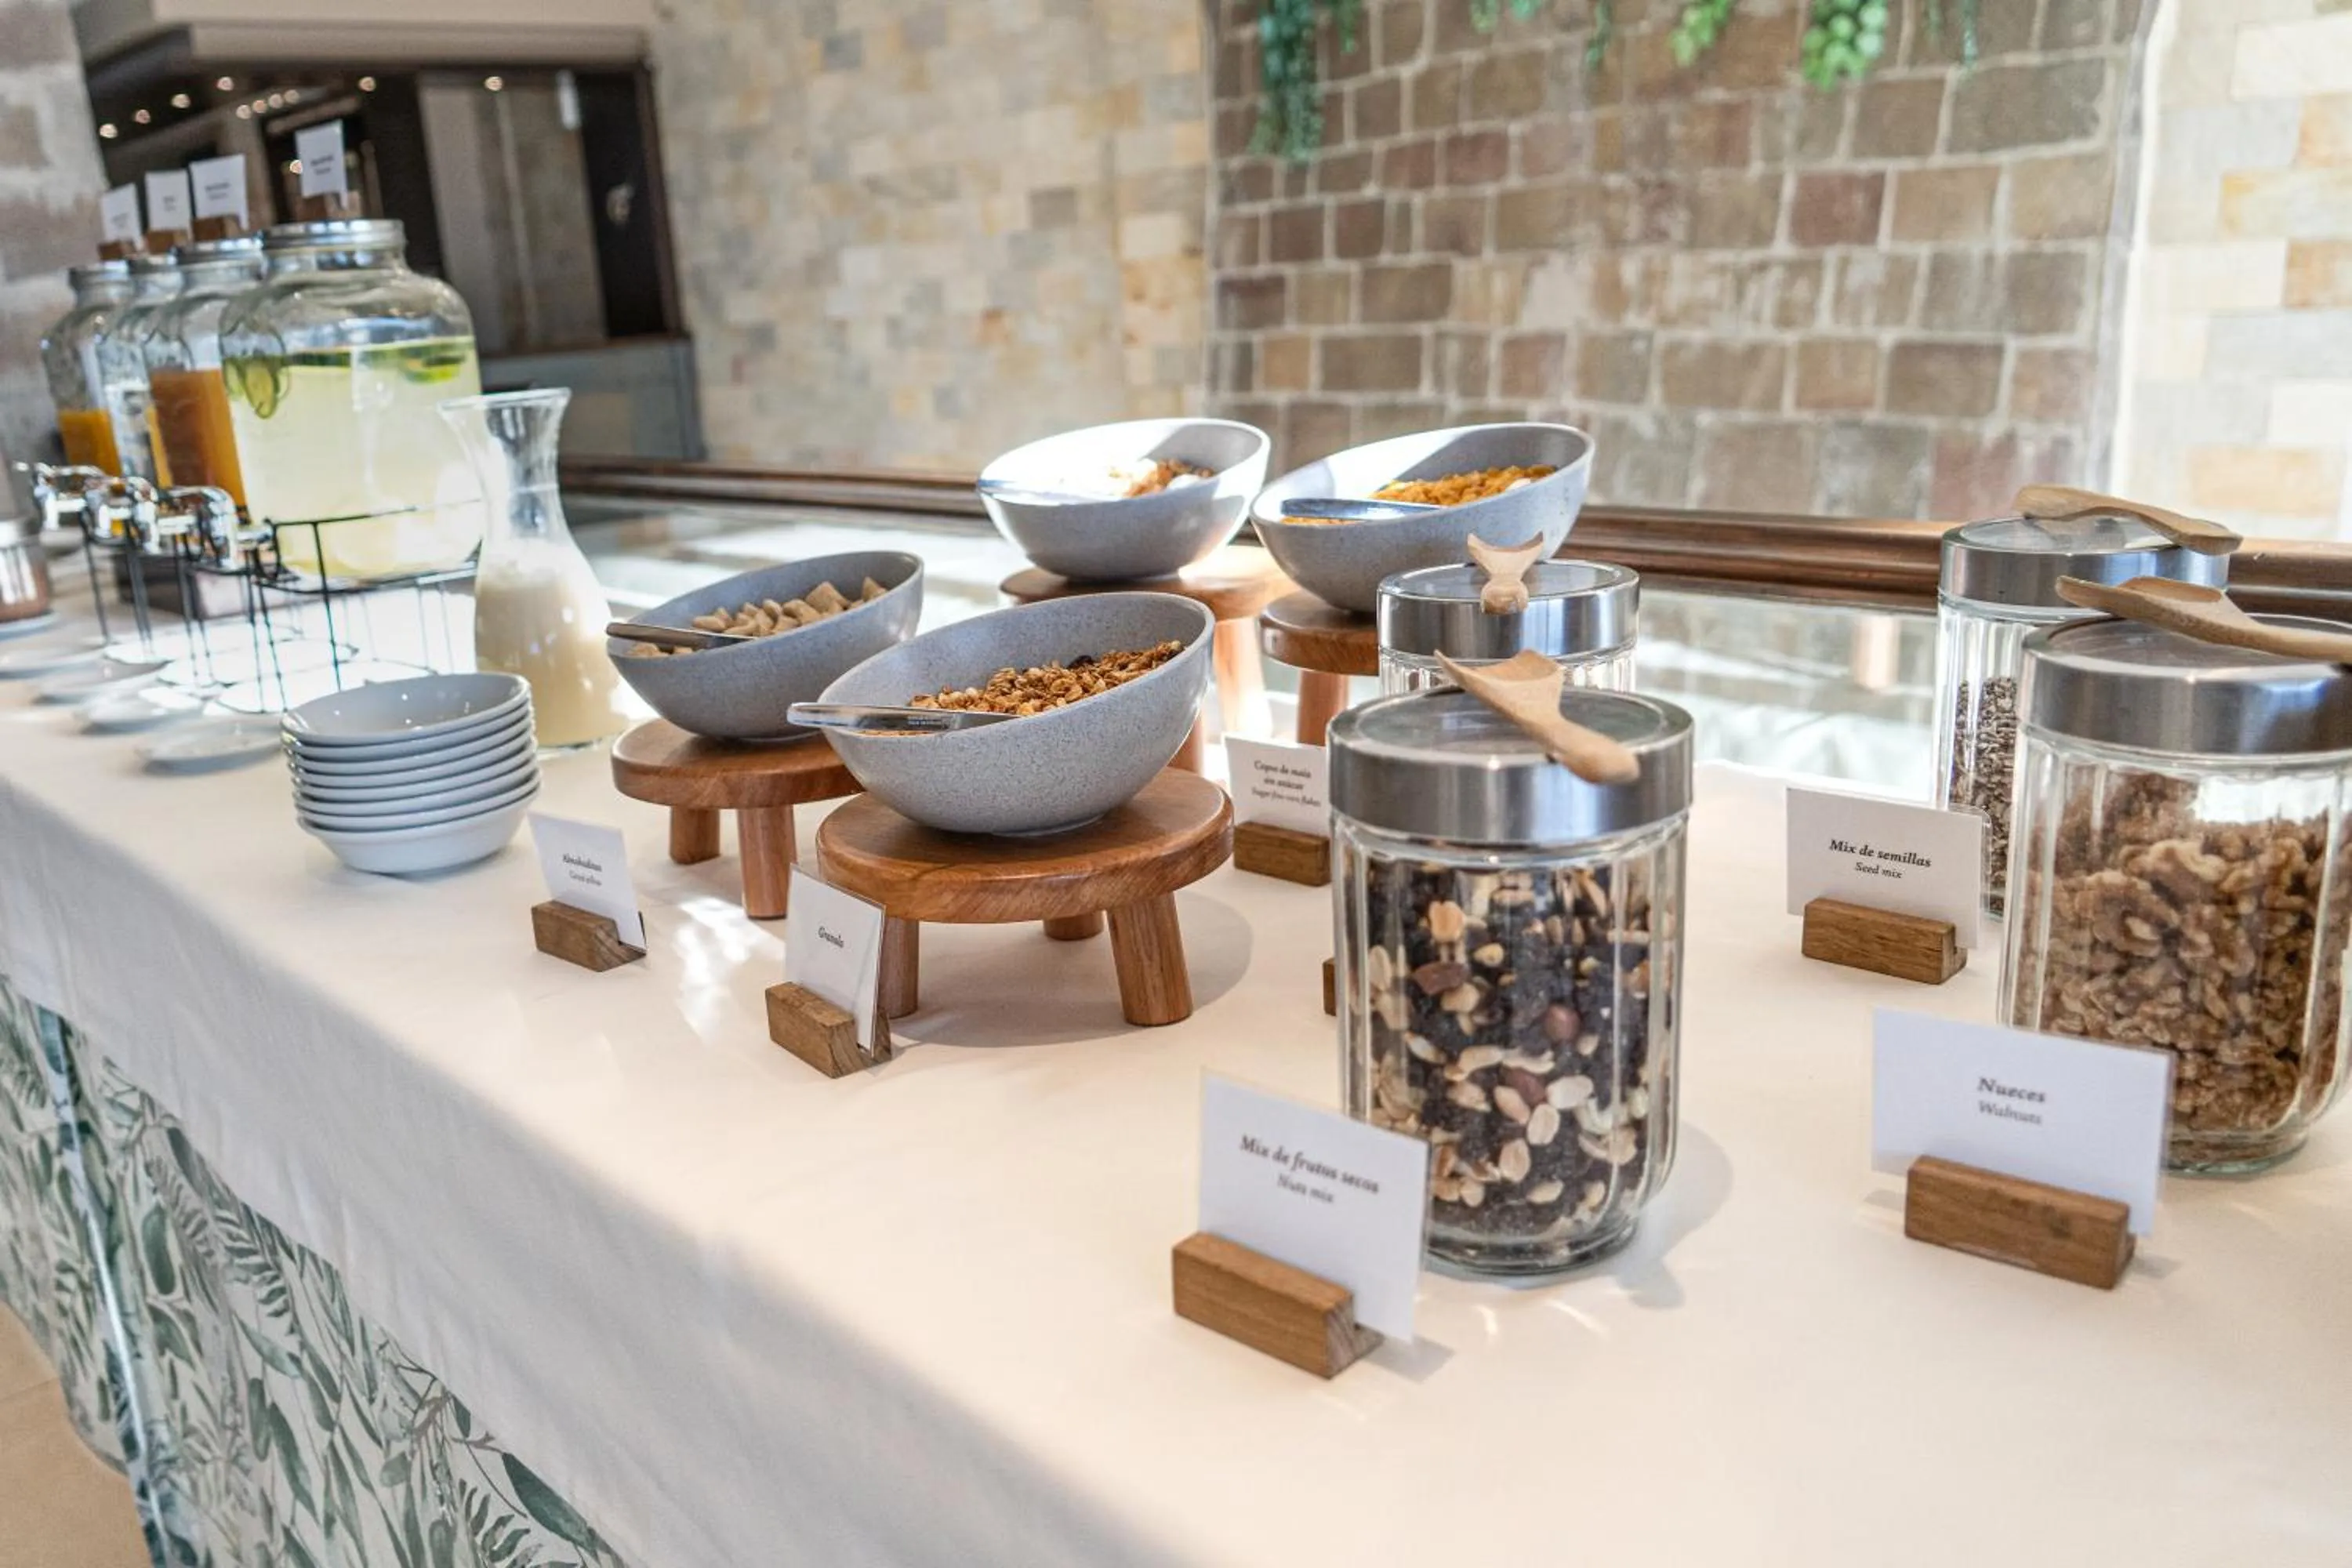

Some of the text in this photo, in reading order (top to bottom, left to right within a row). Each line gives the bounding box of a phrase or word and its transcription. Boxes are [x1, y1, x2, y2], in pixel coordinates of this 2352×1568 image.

[1829, 838, 1932, 868] Mix de semillas
[1854, 861, 1903, 879] Seed mix
[1977, 1076, 2046, 1103] Nueces
[1977, 1100, 2042, 1125] Walnuts
[1239, 1134, 1270, 1159] Mix
[1272, 1145, 1290, 1164] de
[1341, 1171, 1380, 1195] secos
[1276, 1174, 1335, 1204] Nuts mix
